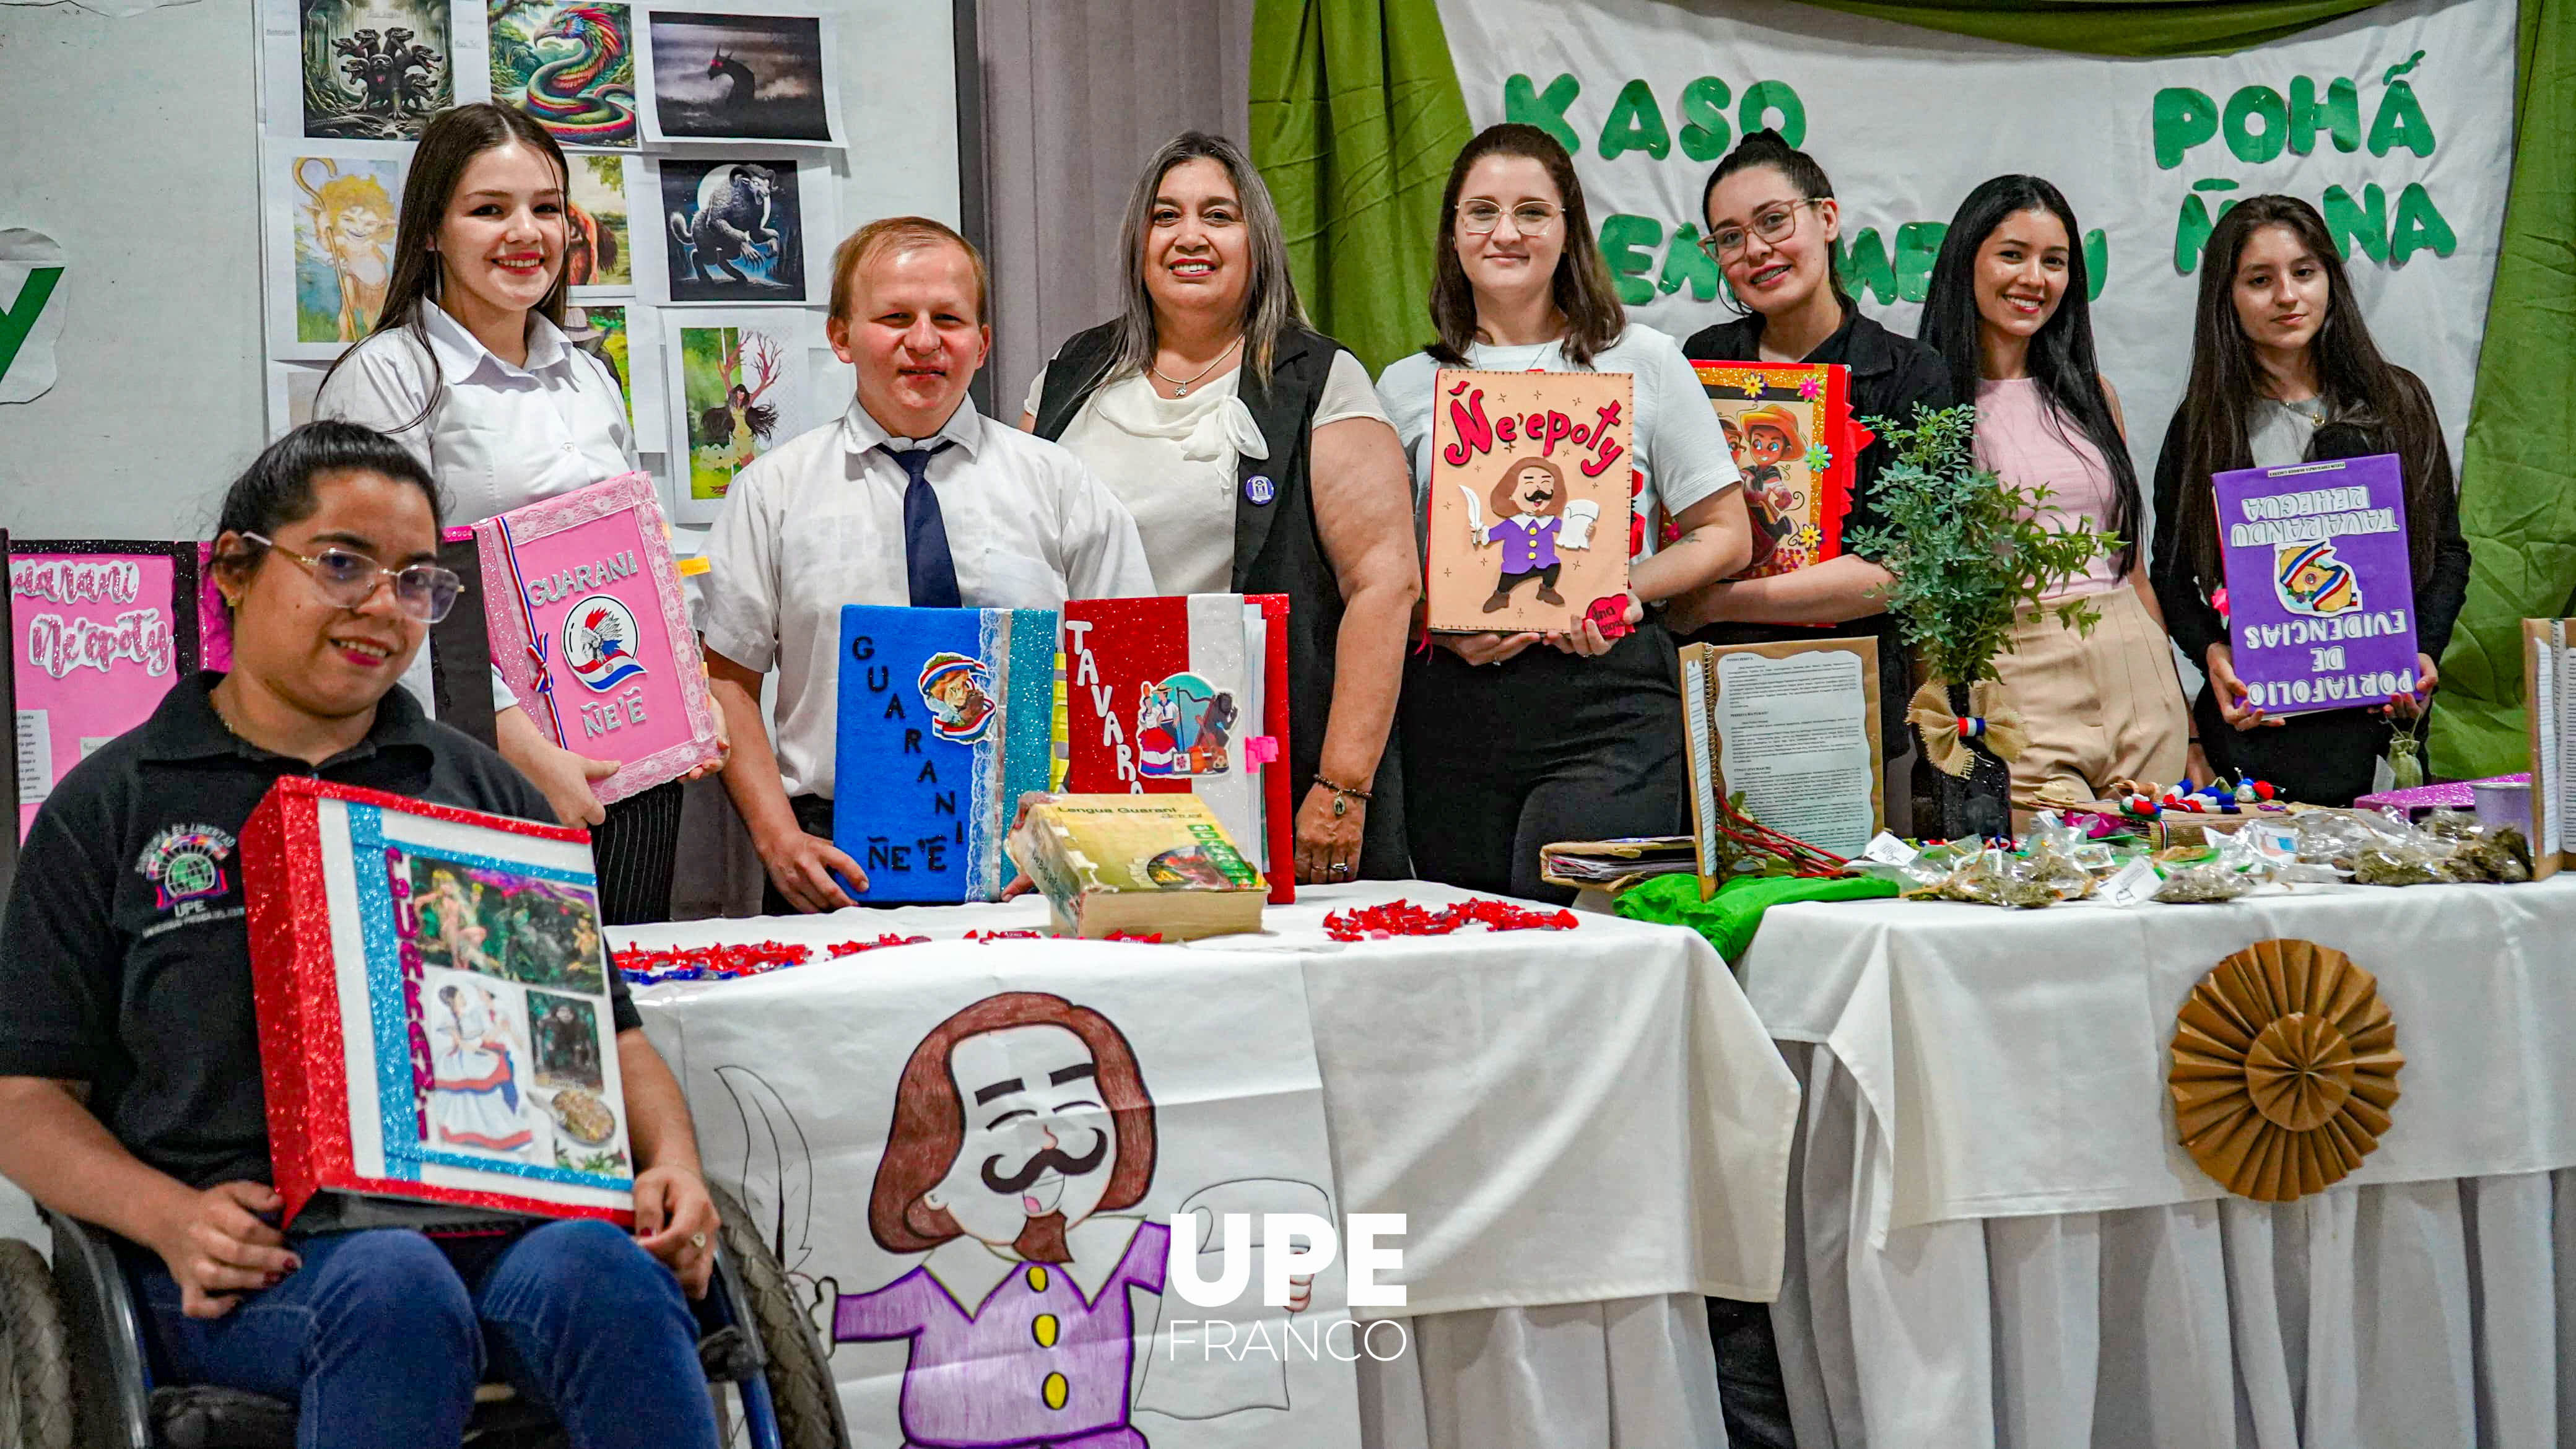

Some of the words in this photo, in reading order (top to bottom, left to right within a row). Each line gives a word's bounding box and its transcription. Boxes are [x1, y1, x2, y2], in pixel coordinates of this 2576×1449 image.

[1505, 73, 1806, 161] KASO
[2242, 485, 2370, 519] REHEGUA
[2232, 507, 2400, 546] TAVARANDU
[526, 550, 638, 607] GUARANI
[2244, 609, 2408, 649] EVIDENCIAS
[2310, 646, 2346, 671] DE
[2247, 668, 2414, 706] PORTAFOLIO
[852, 636, 964, 844] GUARANI
[1057, 806, 1114, 814] Lengua
[174, 900, 207, 918] UPE
